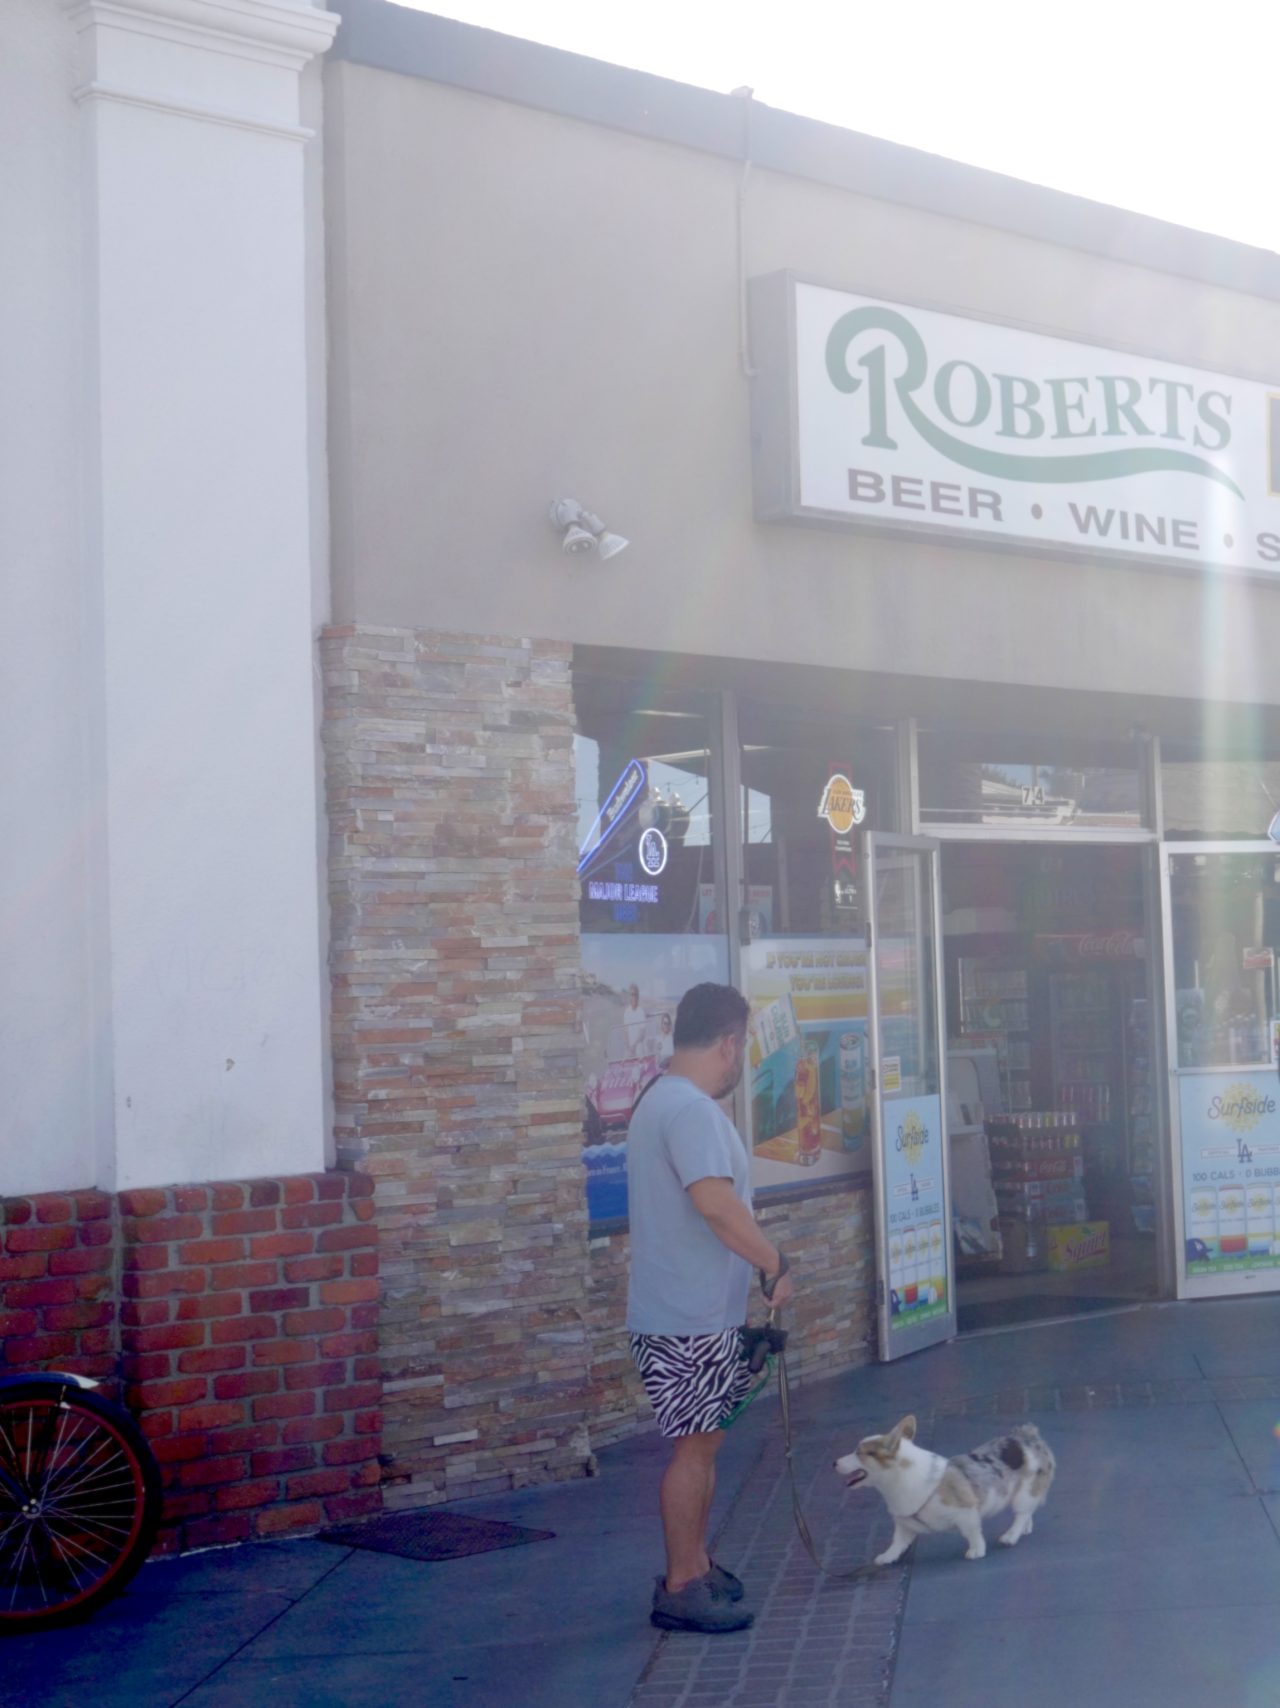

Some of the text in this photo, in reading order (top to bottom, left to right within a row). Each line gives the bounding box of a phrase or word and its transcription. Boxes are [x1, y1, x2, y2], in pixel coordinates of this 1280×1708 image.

[825, 305, 1245, 502] ROBERTS
[847, 467, 1004, 522] BEER
[1068, 502, 1200, 551] WINE
[820, 786, 863, 822] LAKERS
[589, 881, 659, 903] MAJOR LEAGUE
[1208, 1096, 1276, 1119] Surfside
[895, 1122, 930, 1152] Surfside
[1236, 1138, 1253, 1163] LA
[1210, 1170, 1235, 1181] CALS
